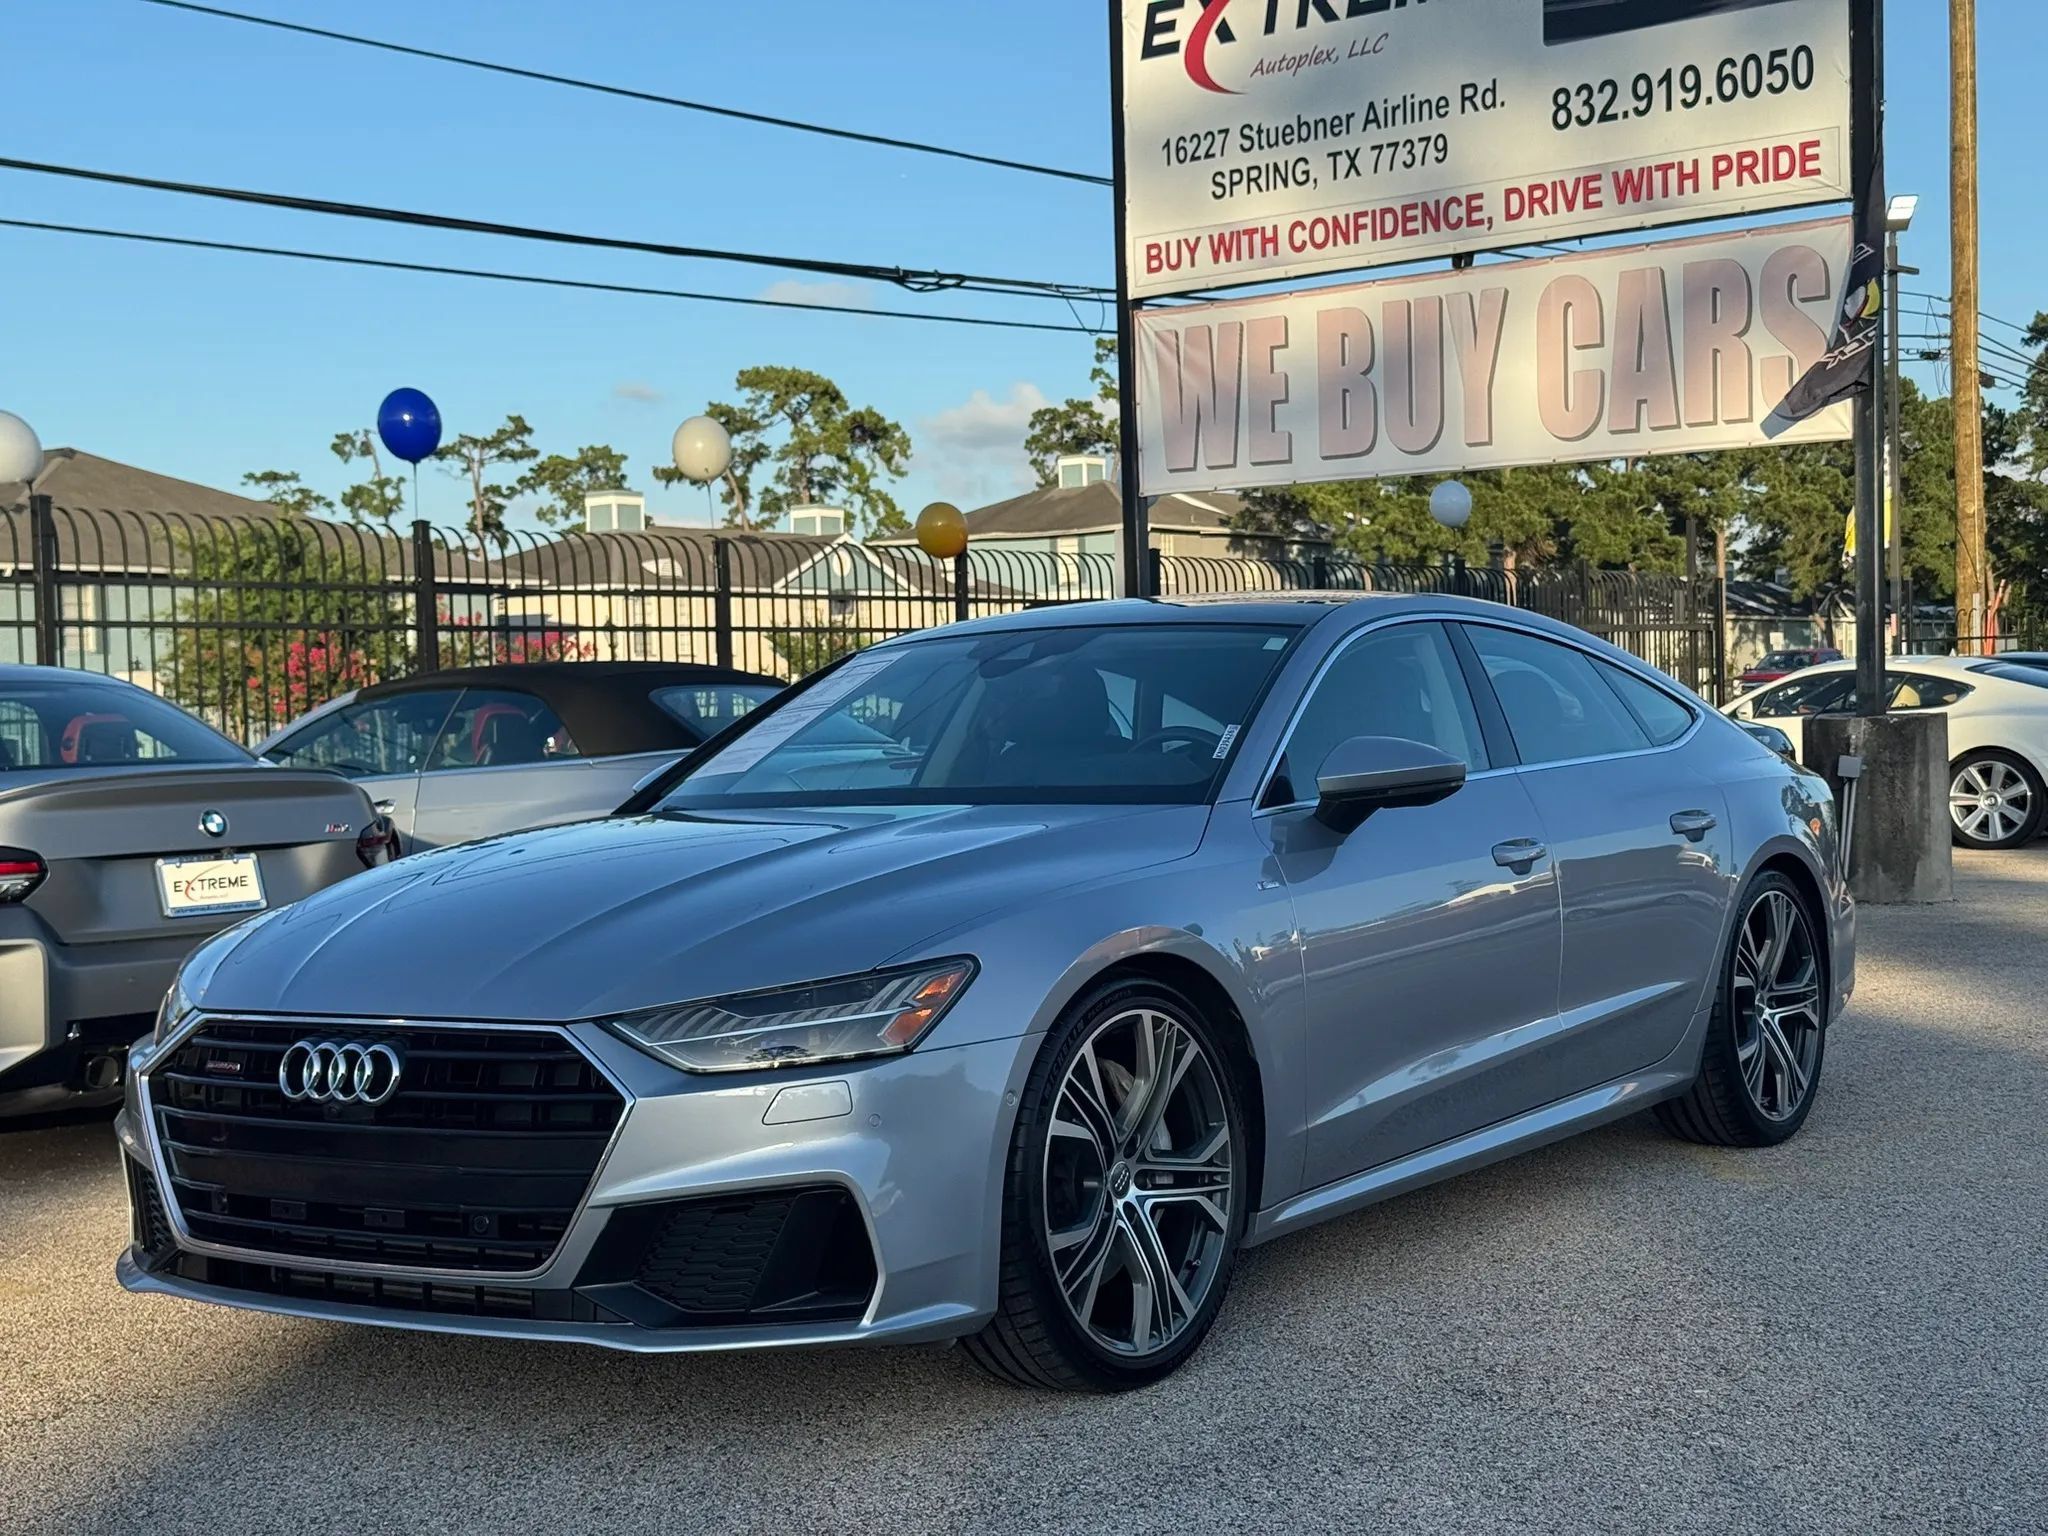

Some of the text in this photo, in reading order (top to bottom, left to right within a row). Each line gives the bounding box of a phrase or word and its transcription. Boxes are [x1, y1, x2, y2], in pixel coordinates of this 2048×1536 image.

[1250, 33, 1389, 78] Autoplex, LLC
[1552, 44, 1814, 131] 832.919.6050
[1161, 78, 1505, 167] 16227 Stuebner Airline Rd.
[1145, 140, 1821, 274] BUY WITH CONFIDENCE, DRIVE WITH PRIDE
[1211, 133, 1448, 200] SPRING, TX 77379
[1154, 244, 1831, 473] WE BUY CARS
[174, 873, 249, 897] EXTREME
